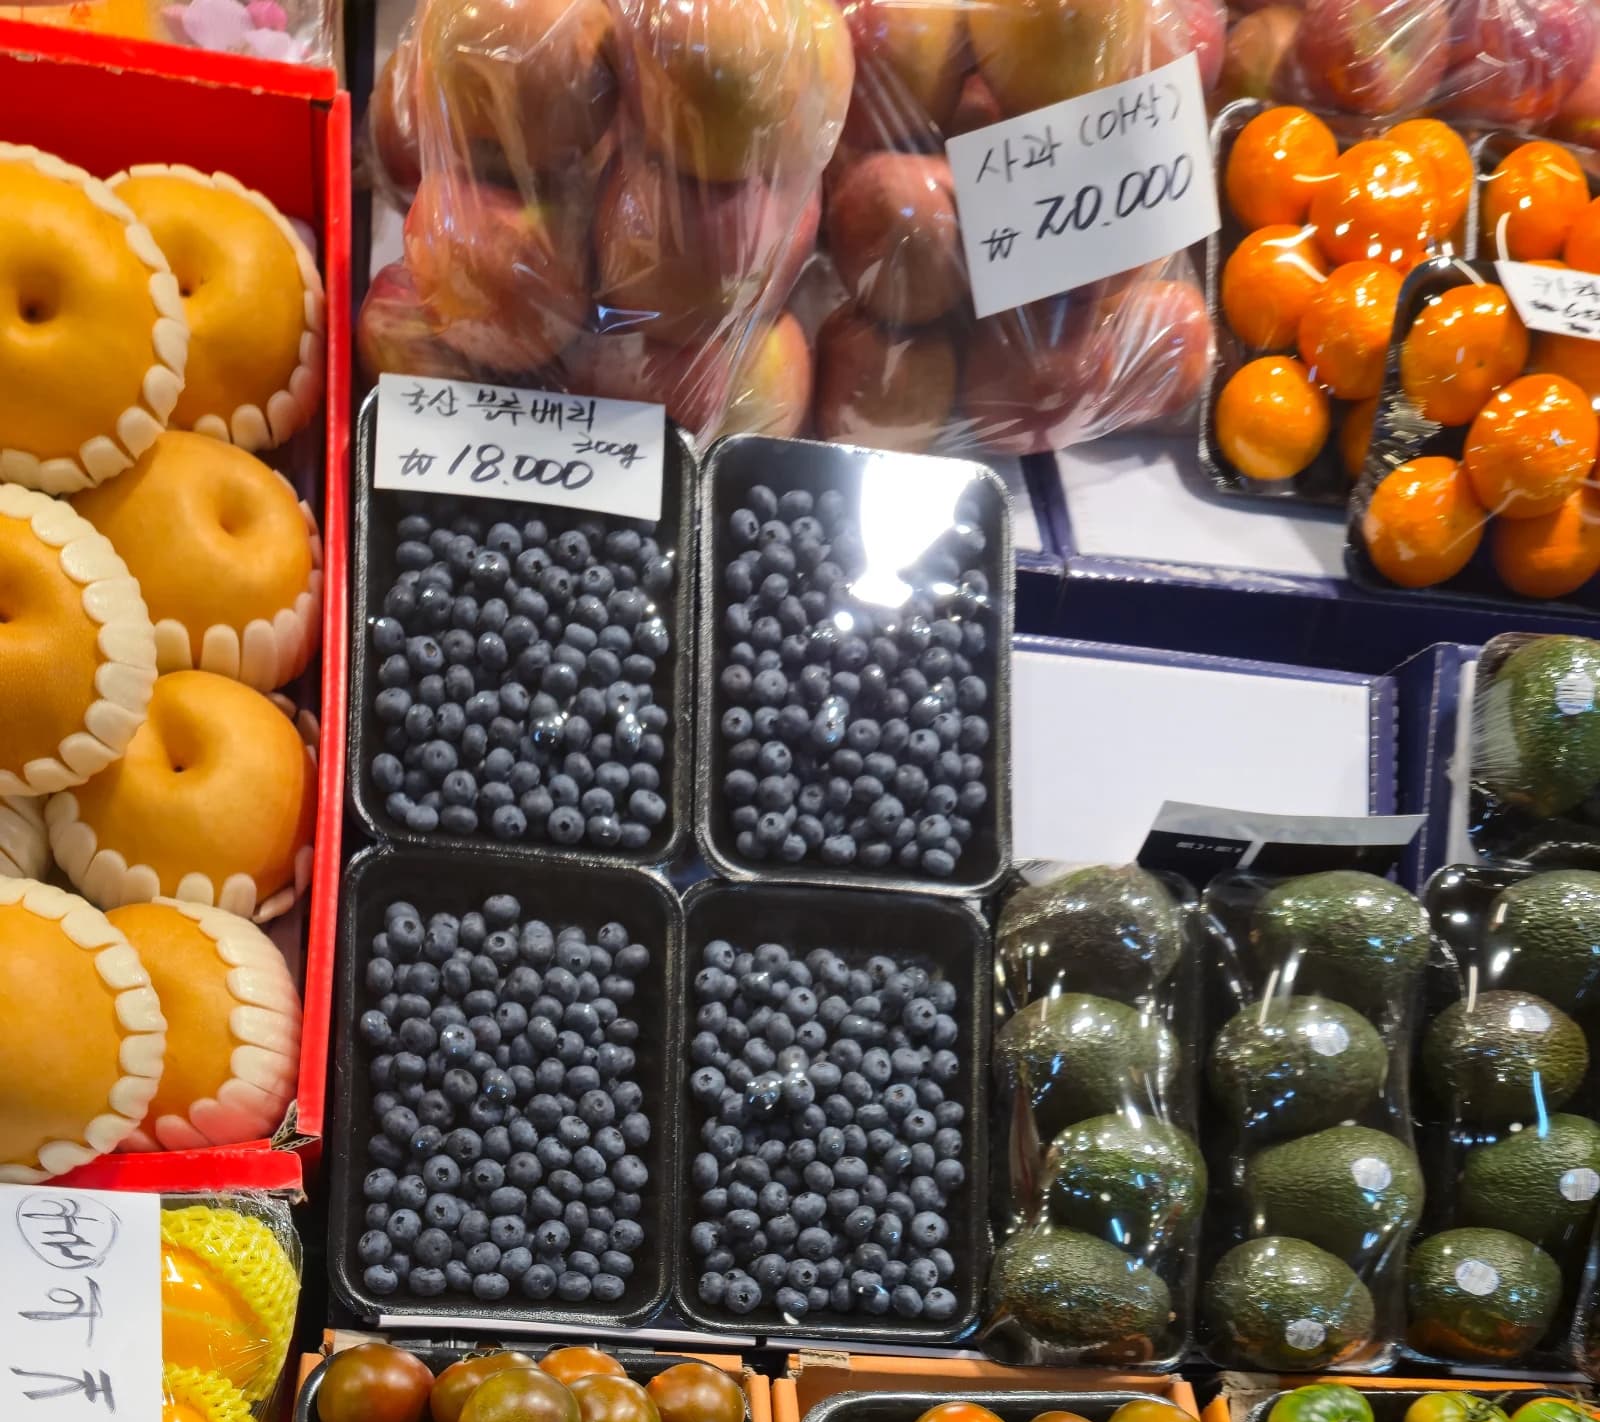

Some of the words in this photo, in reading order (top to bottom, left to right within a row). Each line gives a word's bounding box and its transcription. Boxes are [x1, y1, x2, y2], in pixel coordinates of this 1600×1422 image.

[976, 125, 1061, 183] 사과
[402, 383, 459, 417] 국산
[468, 389, 596, 433] 블루베리
